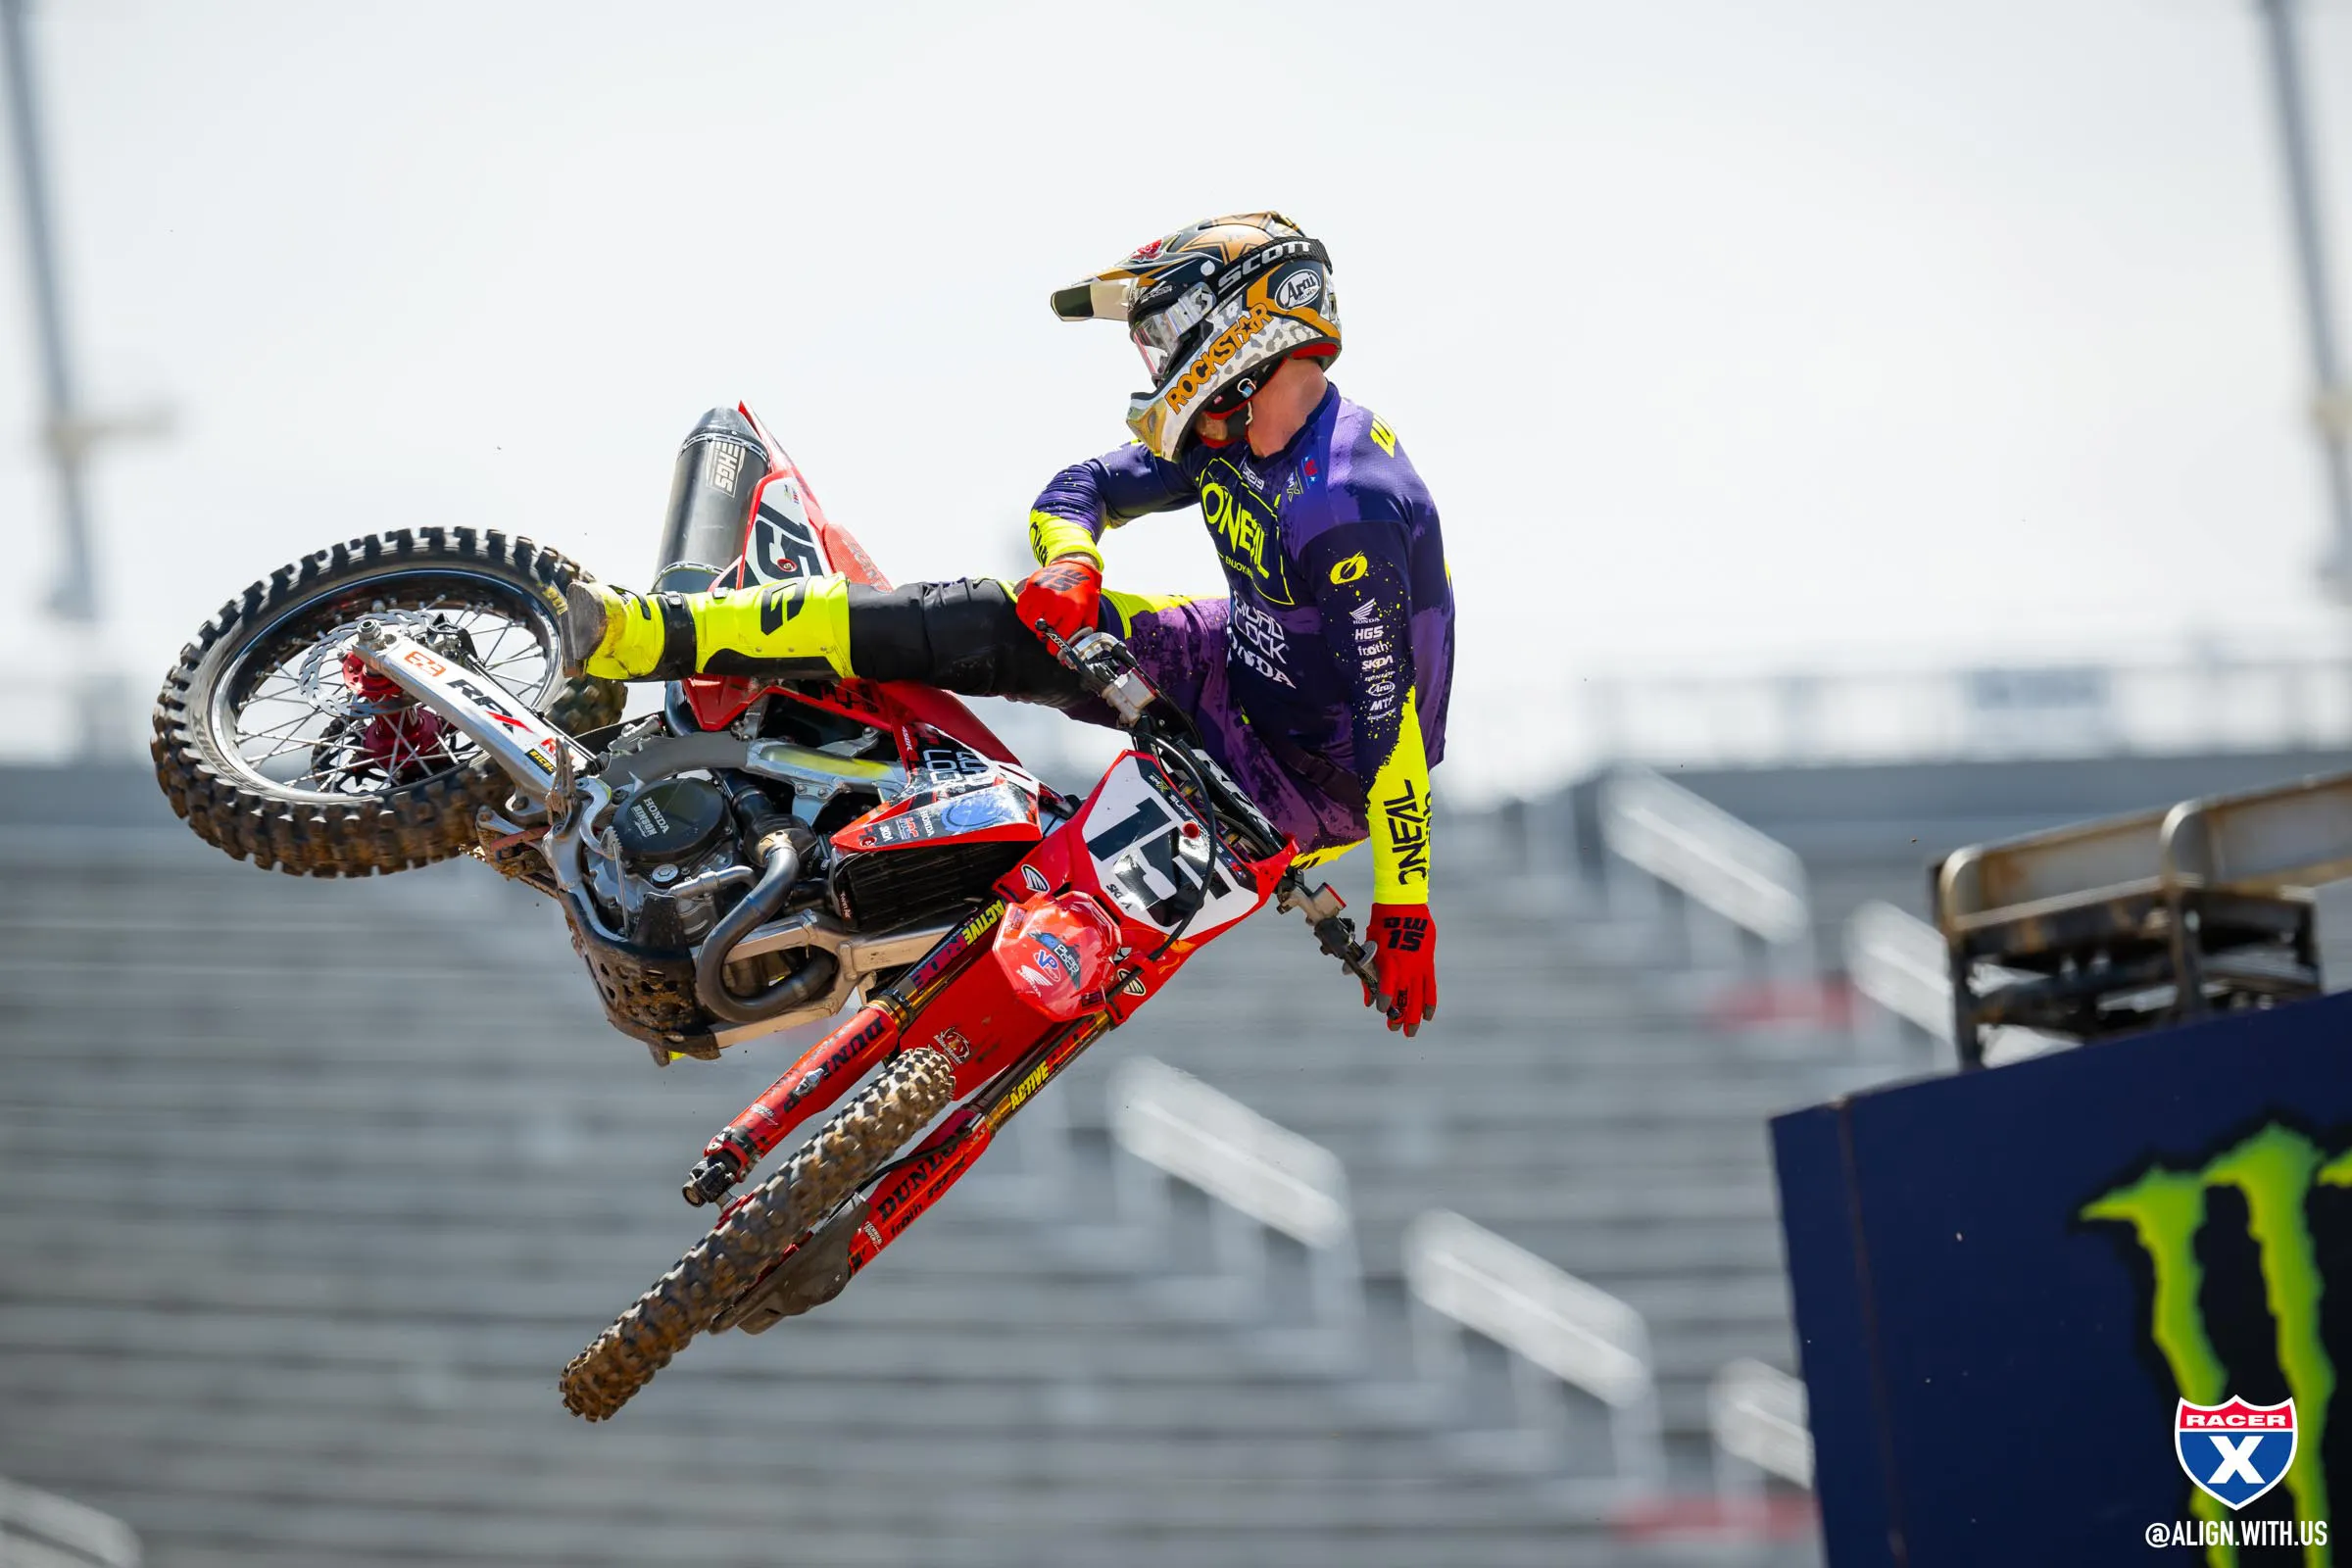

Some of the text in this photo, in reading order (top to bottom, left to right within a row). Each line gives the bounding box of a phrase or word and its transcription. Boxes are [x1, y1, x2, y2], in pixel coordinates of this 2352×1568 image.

[1218, 241, 1311, 295] SCOTT
[714, 458, 740, 492] HGS
[755, 501, 824, 580] 15
[1354, 625, 1384, 641] HGS
[643, 797, 670, 834] HONDA
[920, 808, 935, 838] HONDA
[1388, 929, 1425, 951] 15
[1038, 949, 1059, 969] VP
